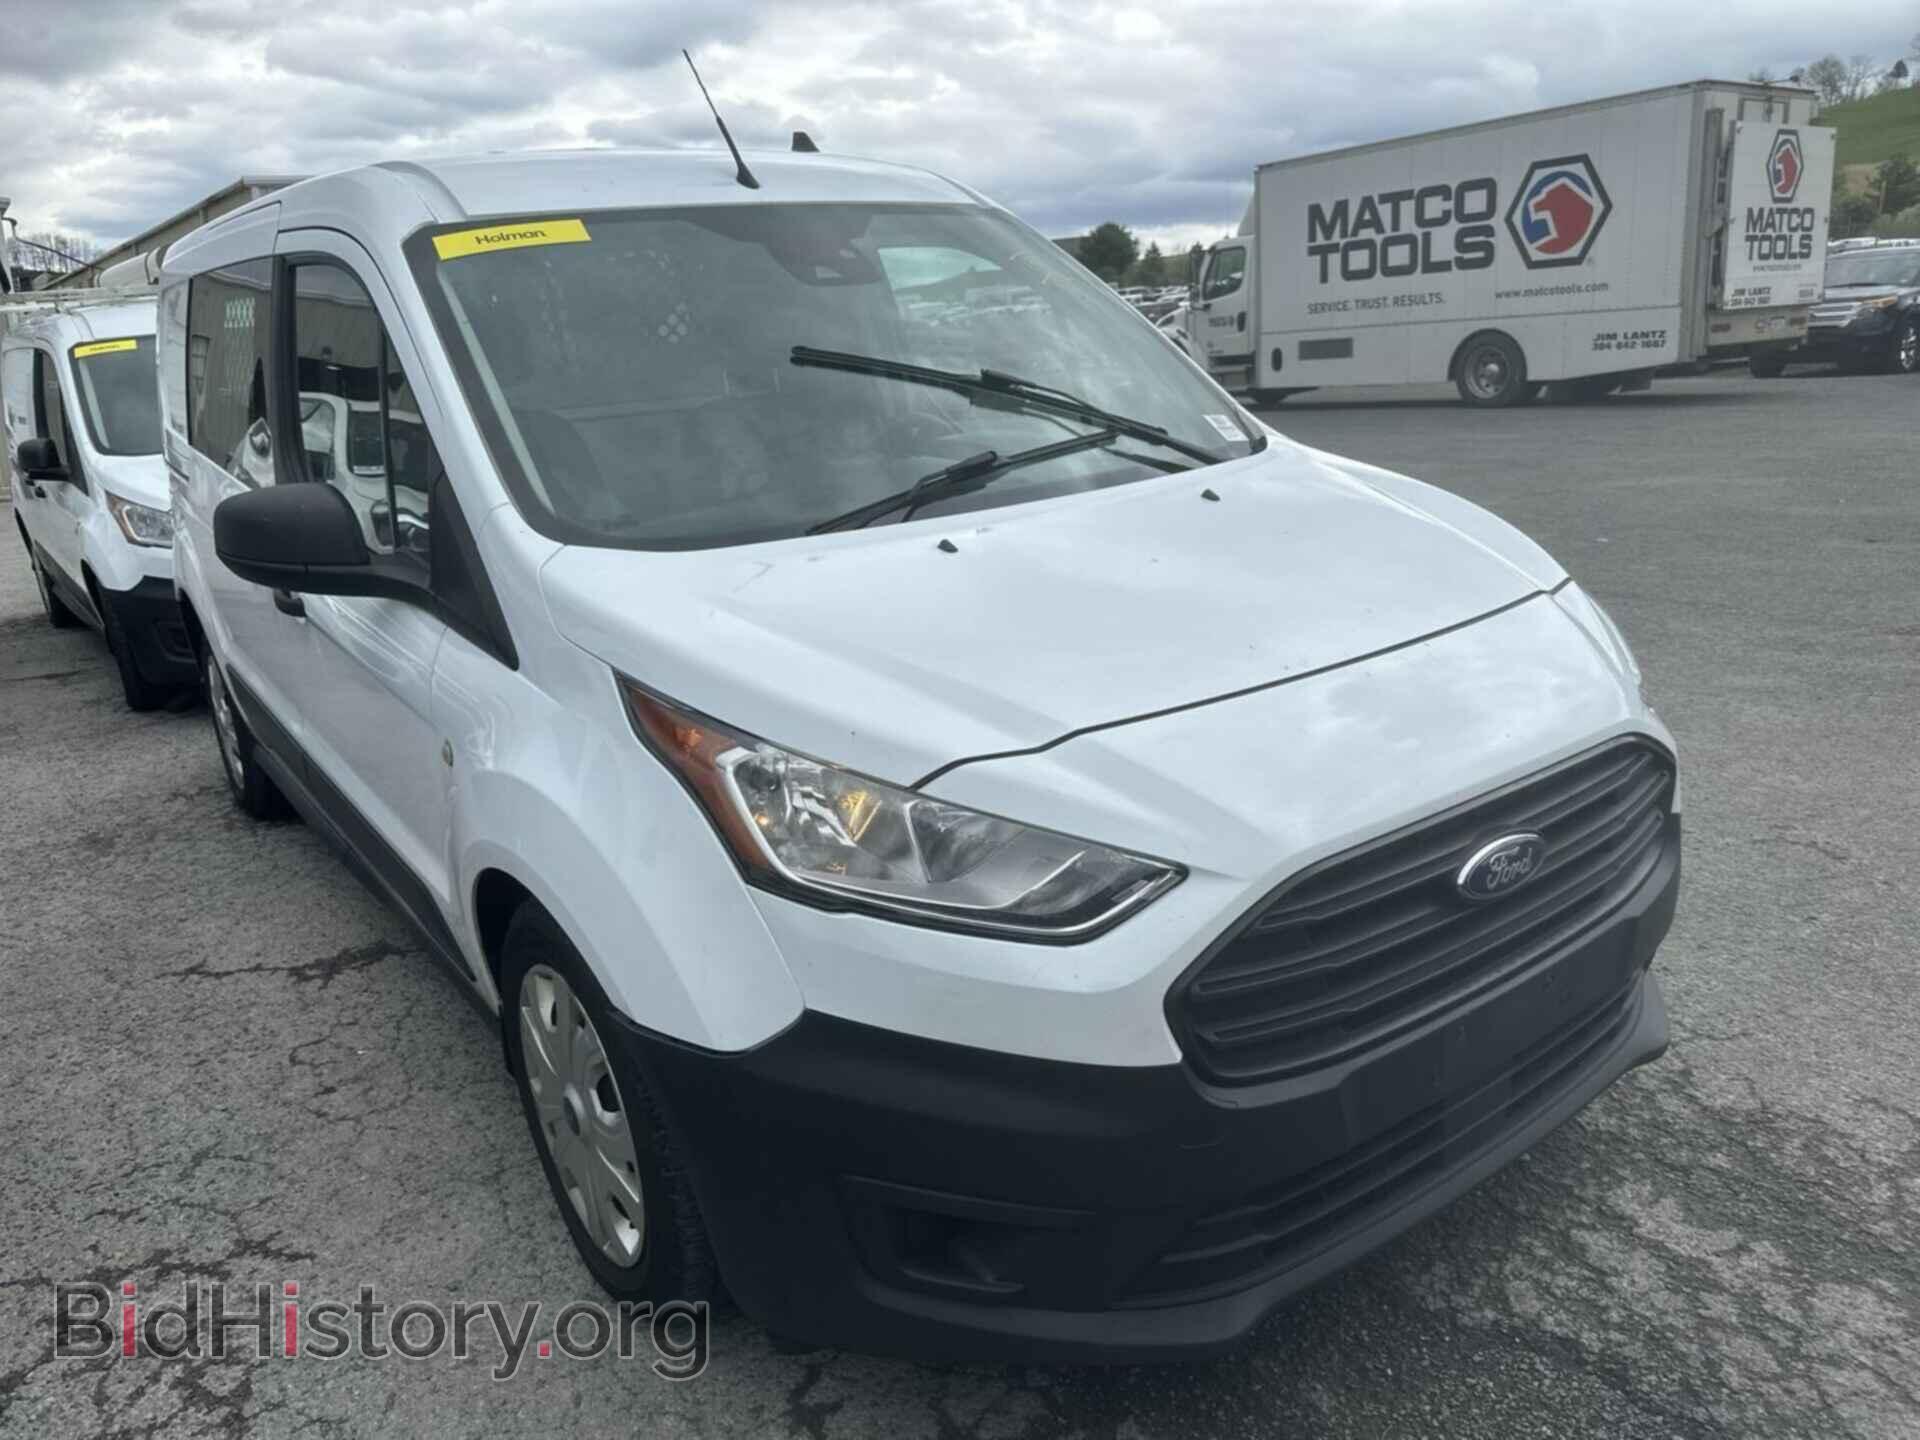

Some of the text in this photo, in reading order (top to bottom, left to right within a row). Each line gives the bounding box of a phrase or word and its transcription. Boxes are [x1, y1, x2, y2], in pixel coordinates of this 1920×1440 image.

[1307, 177, 1497, 243] MATCO
[1746, 206, 1815, 233] MATCO
[474, 230, 546, 245] Holman
[1744, 233, 1812, 262] TOOLS
[1307, 223, 1496, 284] TOOLS
[1495, 282, 1609, 299] www.matcotools.com
[1592, 329, 1667, 342] JIM LANTZ
[1486, 846, 1533, 891] Ford
